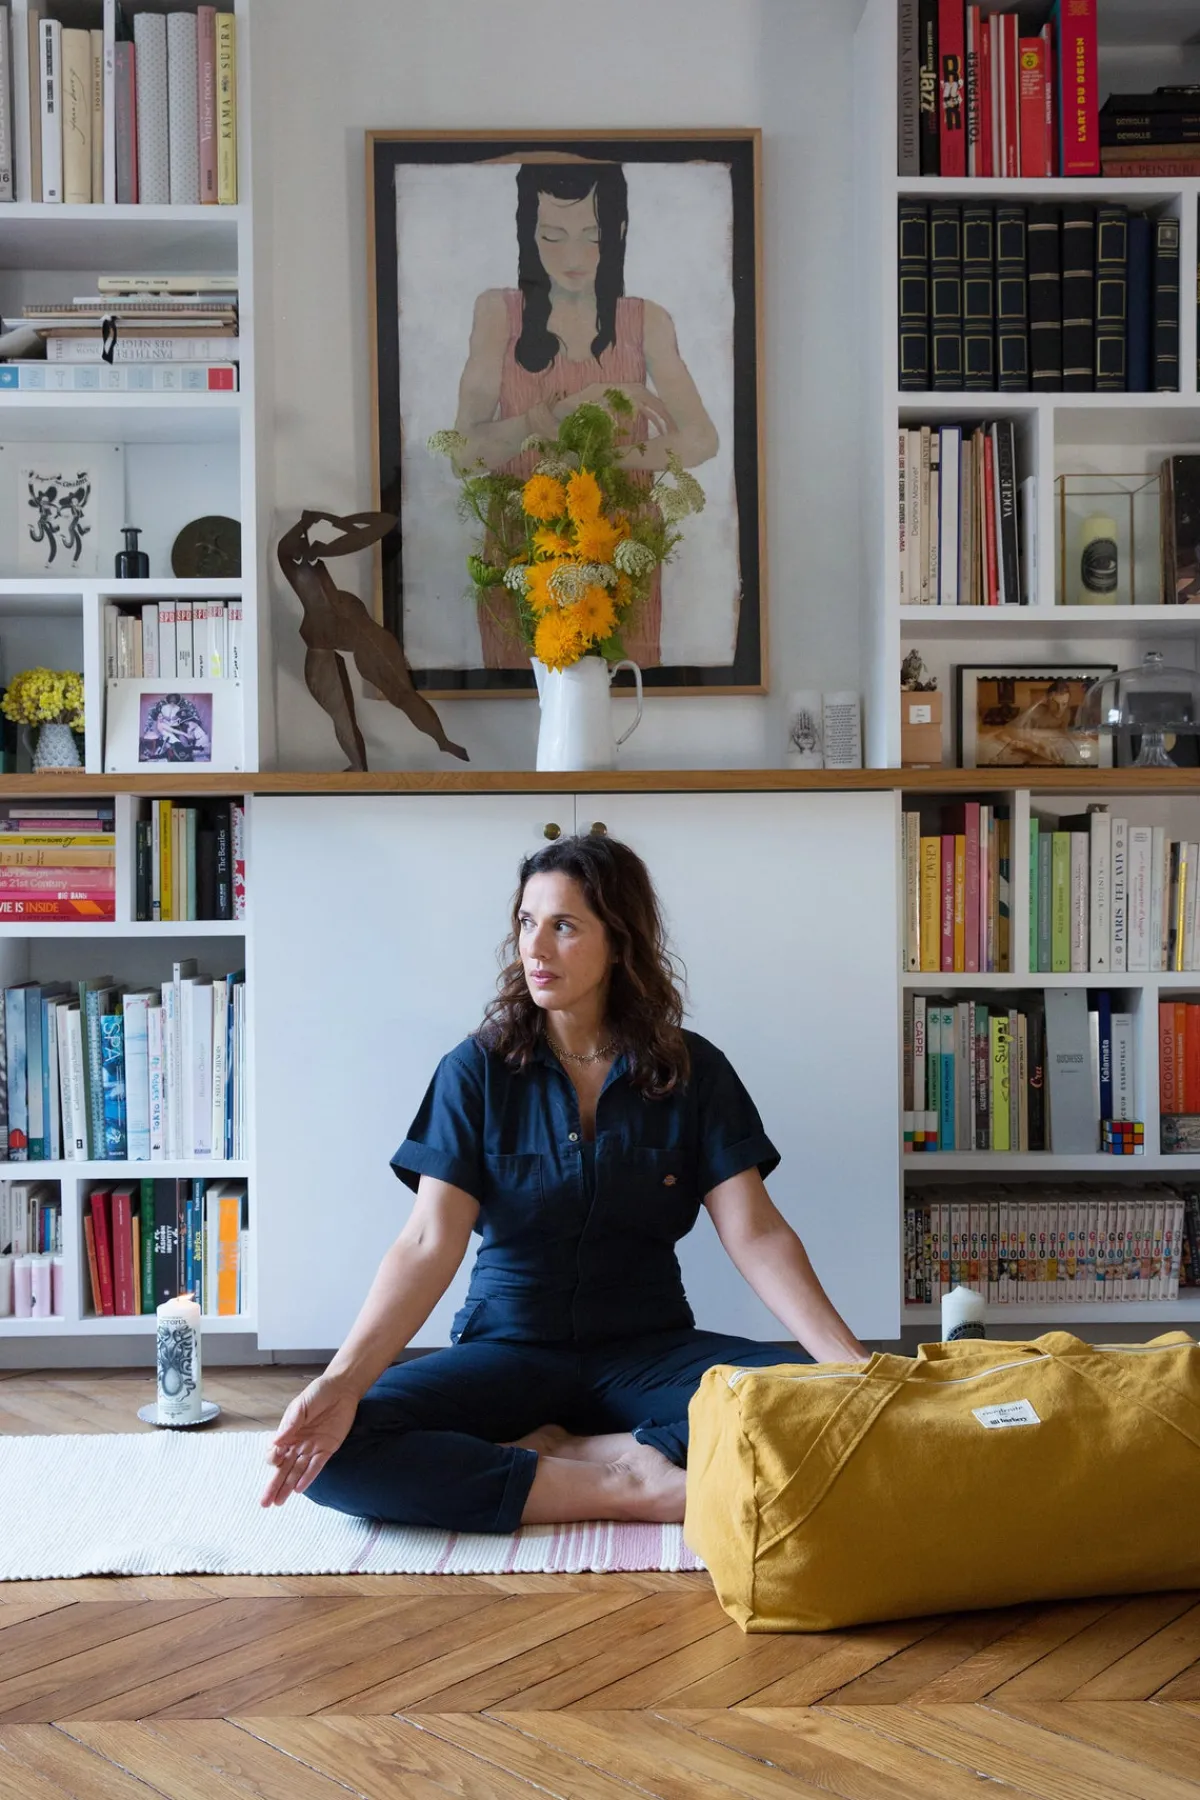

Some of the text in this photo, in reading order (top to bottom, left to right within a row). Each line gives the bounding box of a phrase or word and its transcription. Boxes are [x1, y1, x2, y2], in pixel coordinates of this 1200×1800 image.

[220, 23, 232, 68] SUTRA
[901, 3, 914, 159] PATRICK DEMARCHELIER
[920, 65, 937, 113] Jazz
[968, 50, 980, 146] TOILETPAPER
[1075, 36, 1087, 142] L'ART DU DESIGN
[221, 99, 232, 139] KAMA
[1001, 479, 1013, 518] VOGUE
[217, 829, 227, 873] The Beatles
[15, 902, 25, 912] IS
[26, 903, 60, 912] INSIDE
[1114, 853, 1124, 942] PARIS TEL AVIV
[102, 1022, 121, 1062] SPA
[915, 1020, 924, 1057] CAPRI
[1029, 1064, 1043, 1088] Cru
[1101, 1039, 1110, 1082] Kalamata
[1163, 1028, 1173, 1100] COOKBOOK
[979, 1083, 987, 1111] CALIFORNIA
